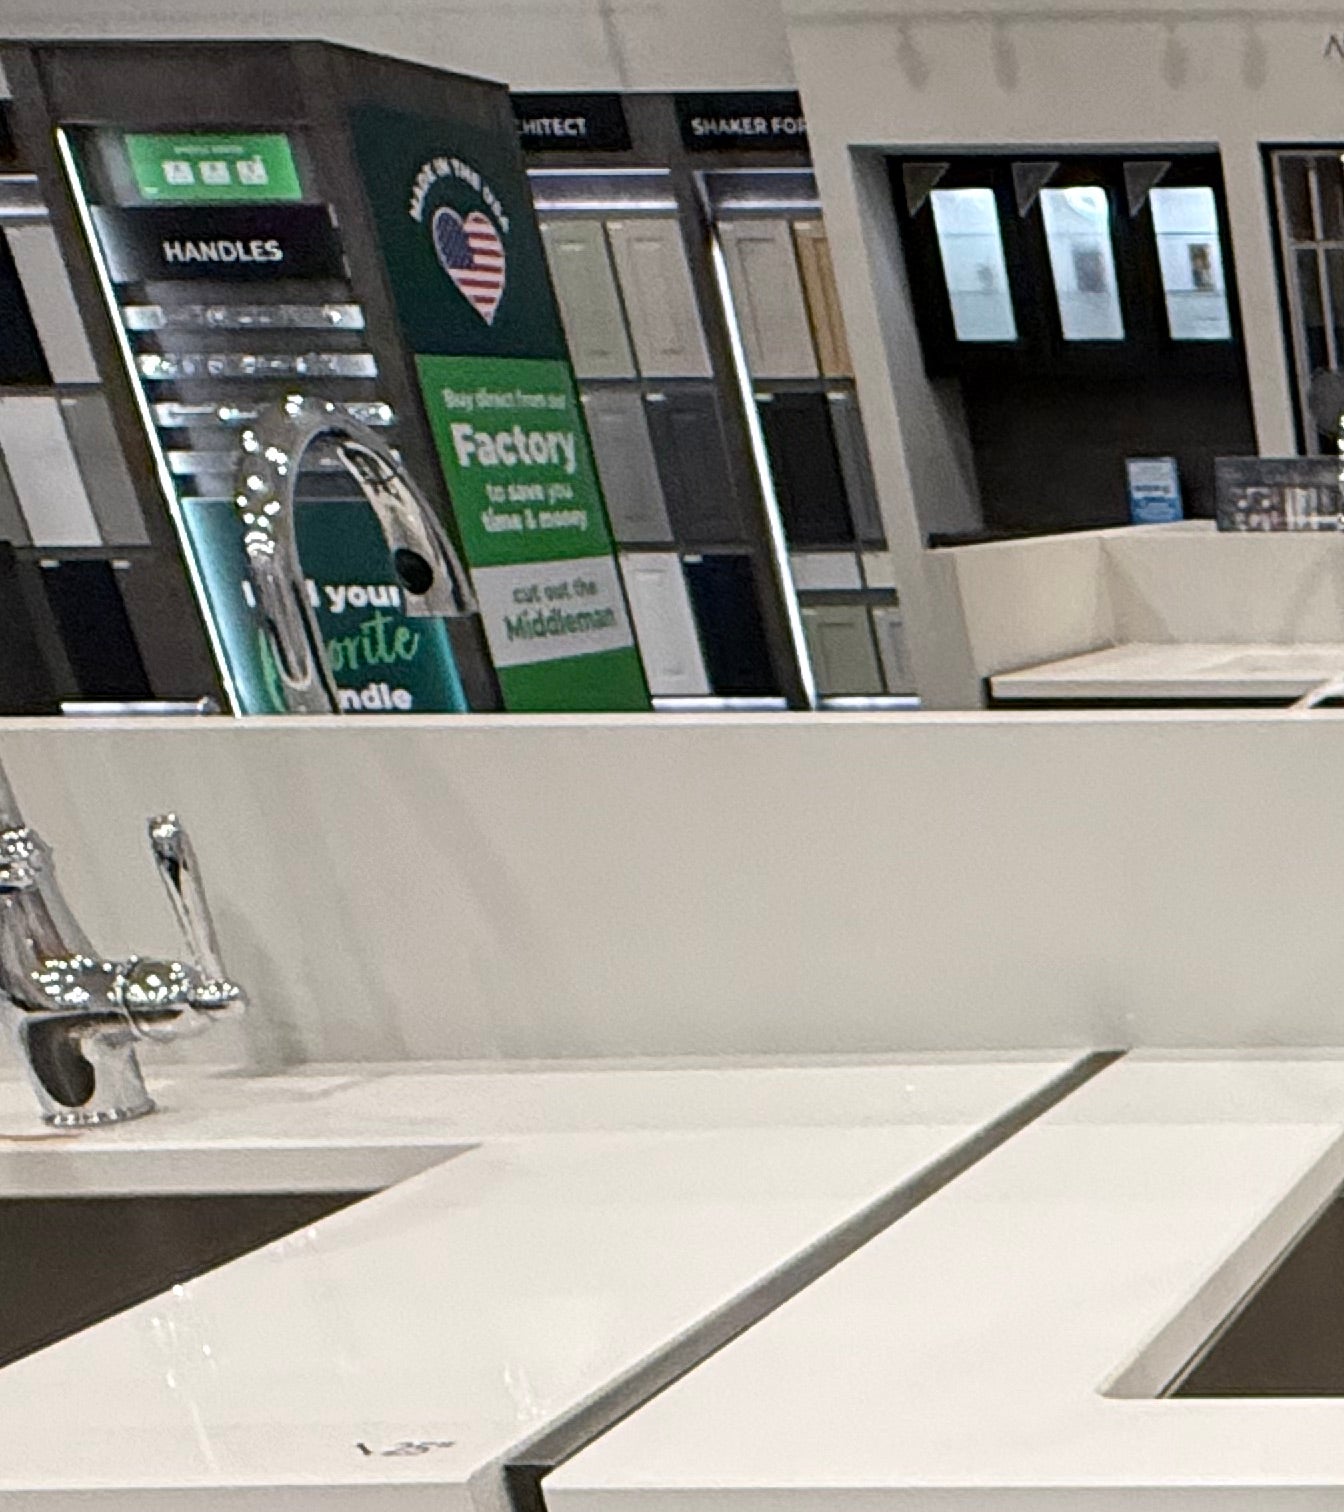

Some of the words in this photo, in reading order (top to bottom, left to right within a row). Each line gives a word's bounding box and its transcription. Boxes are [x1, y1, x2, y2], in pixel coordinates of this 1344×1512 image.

[691, 116, 768, 136] SHAKER
[408, 162, 438, 223] MADE
[450, 157, 482, 193] THE
[482, 185, 510, 234] USA
[162, 239, 284, 263] HANDLES
[450, 422, 577, 475] Factory
[502, 607, 617, 642] Middleman
